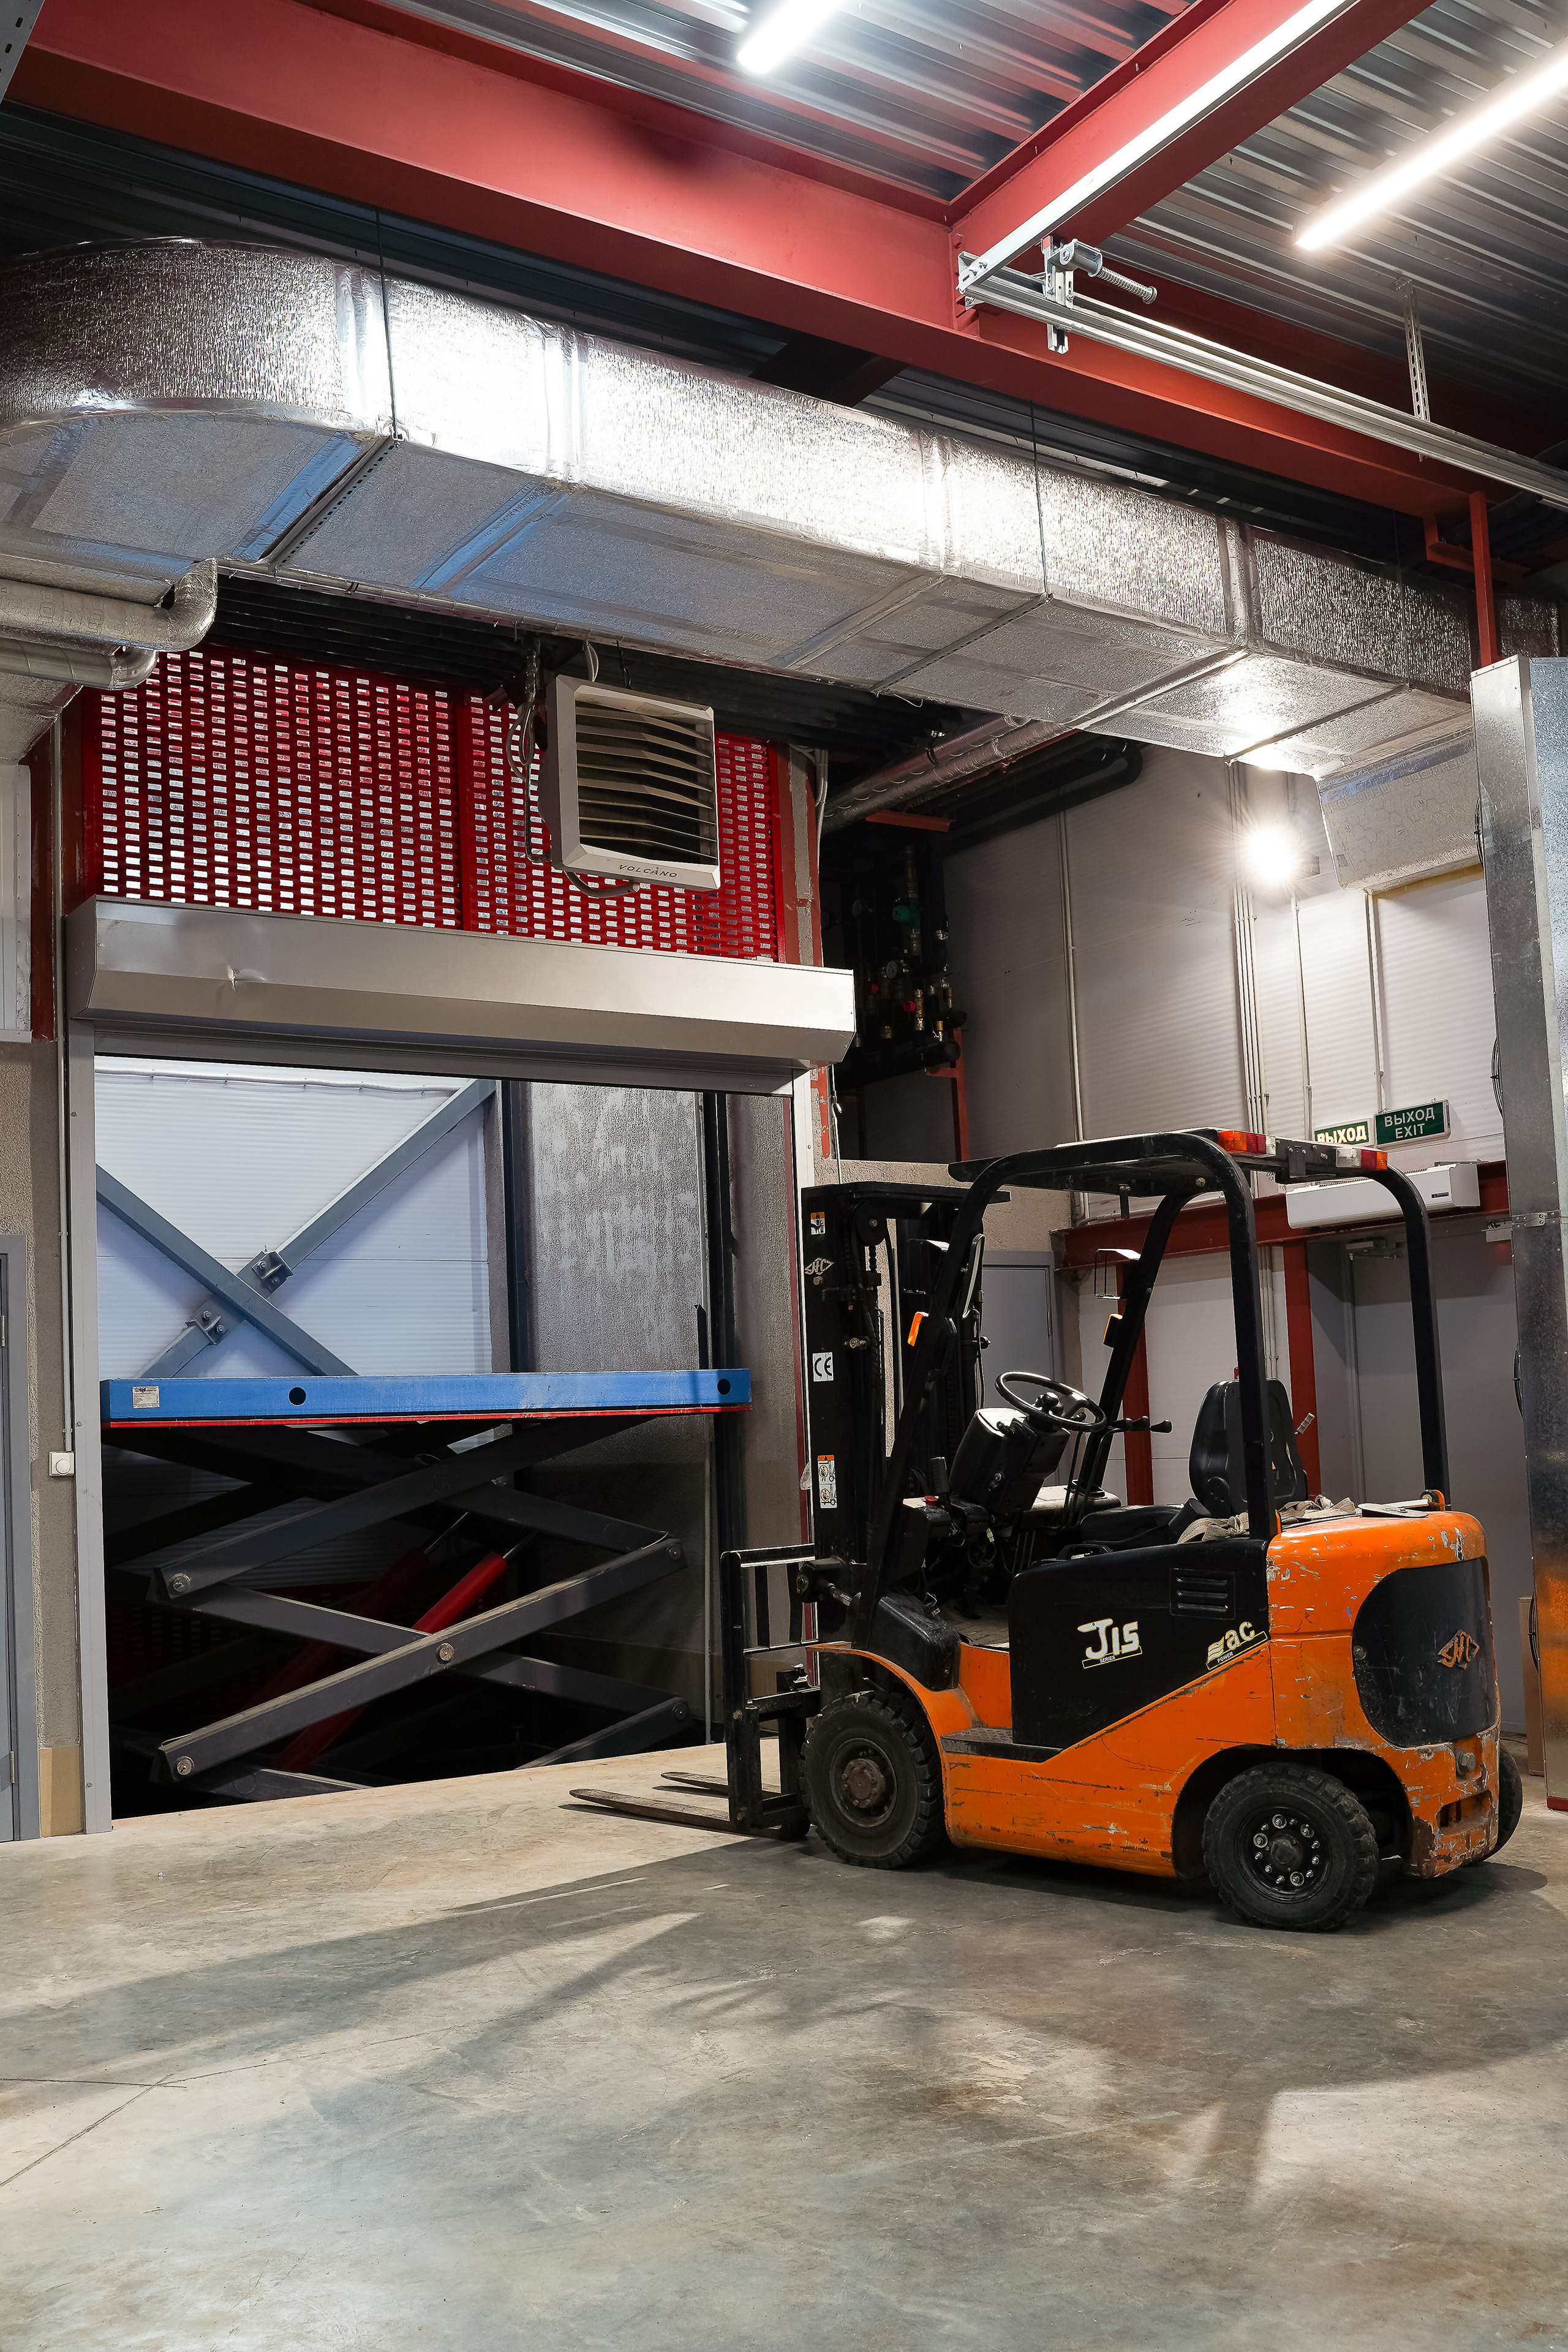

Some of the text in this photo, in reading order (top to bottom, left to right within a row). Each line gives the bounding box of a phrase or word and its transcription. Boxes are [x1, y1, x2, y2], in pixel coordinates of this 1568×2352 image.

[619, 864, 677, 878] VOLCANO
[1384, 1107, 1435, 1128] ВЫХОД
[1317, 1125, 1367, 1144] ВЫХОД
[1395, 1123, 1425, 1139] EXIT
[814, 1356, 833, 1378] CE
[1099, 1655, 1115, 1664] SERIES
[1217, 1651, 1234, 1664] POWER
